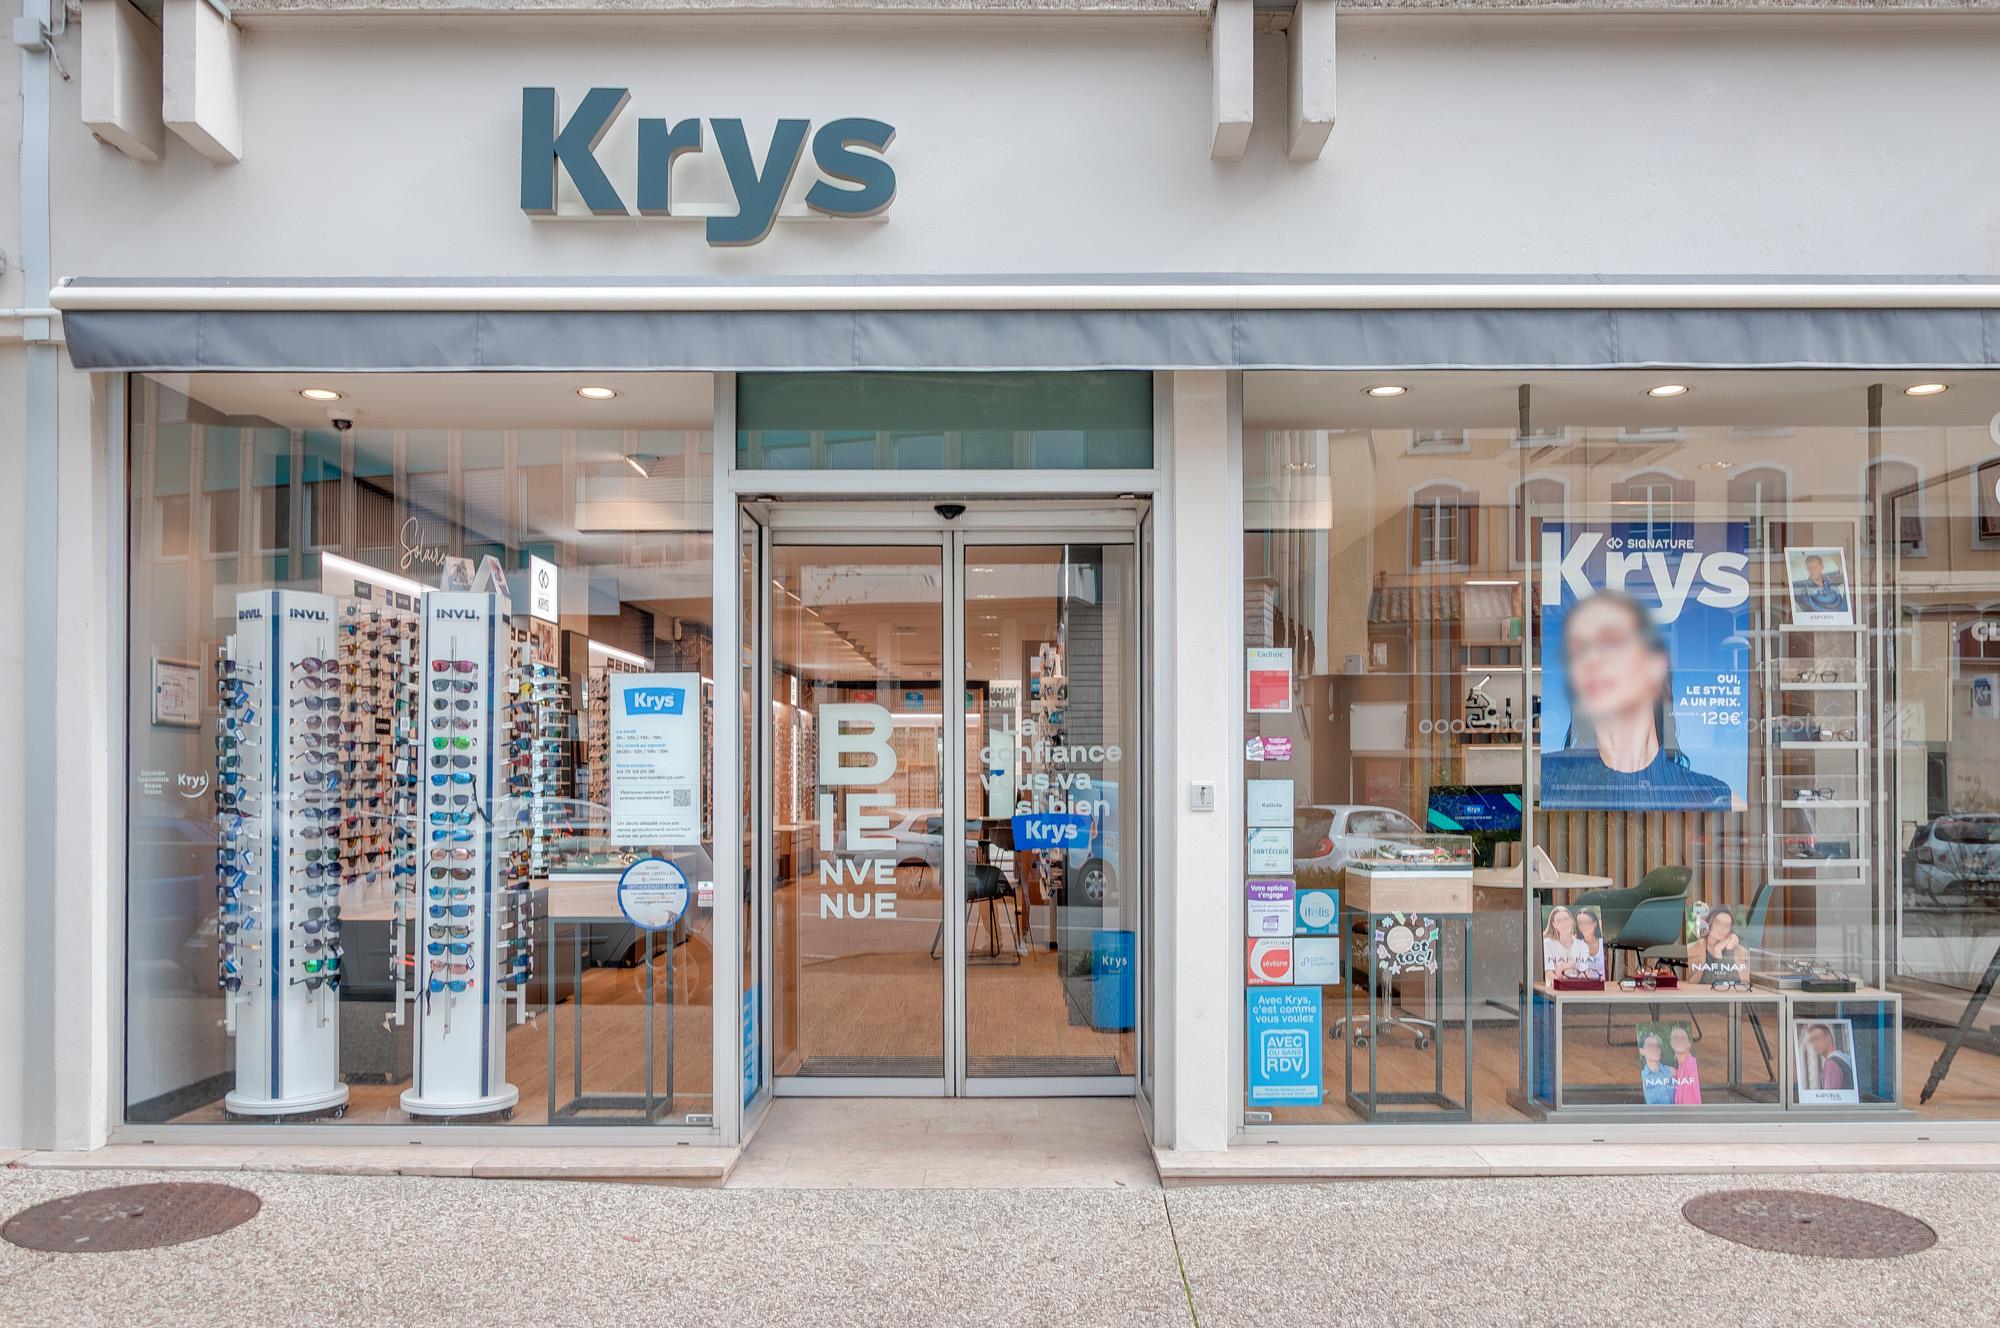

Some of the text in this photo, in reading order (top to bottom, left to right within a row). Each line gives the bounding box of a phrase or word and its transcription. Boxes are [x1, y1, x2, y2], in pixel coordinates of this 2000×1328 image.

[520, 87, 897, 247] Krys
[1627, 538, 1695, 550] SIGNATURE
[1541, 532, 1750, 625] Krys
[290, 608, 329, 622] INVU.
[436, 608, 480, 620] INVU.
[1717, 674, 1741, 685] OUI,
[1686, 686, 1741, 695] LE STYLE
[634, 692, 675, 711] Krys
[1691, 697, 1707, 706] UN
[1710, 697, 1741, 707] PRIX.
[1003, 713, 1036, 736] La
[819, 703, 897, 785] B
[980, 742, 1122, 763] cnfiance
[177, 773, 206, 789] Krys
[1058, 773, 1092, 790] va
[1017, 796, 1110, 817] si bien
[819, 794, 897, 850] IE
[1025, 820, 1078, 844] Krys
[820, 859, 897, 885] NVE
[1250, 883, 1289, 893] Votre opticien
[820, 893, 897, 919] NUE
[1412, 942, 1428, 952] et
[1102, 955, 1128, 969] Krys
[1691, 963, 1747, 972] NAF NAF
[1258, 995, 1311, 1008] Avec Krys,
[1252, 1005, 1317, 1014] c'est comme
[1255, 1013, 1314, 1023] vous voulez
[1267, 1036, 1303, 1048] AVEC
[1266, 1058, 1304, 1073] RDV
[1645, 1078, 1670, 1086] NAF
[1671, 1077, 1695, 1085] NAF
